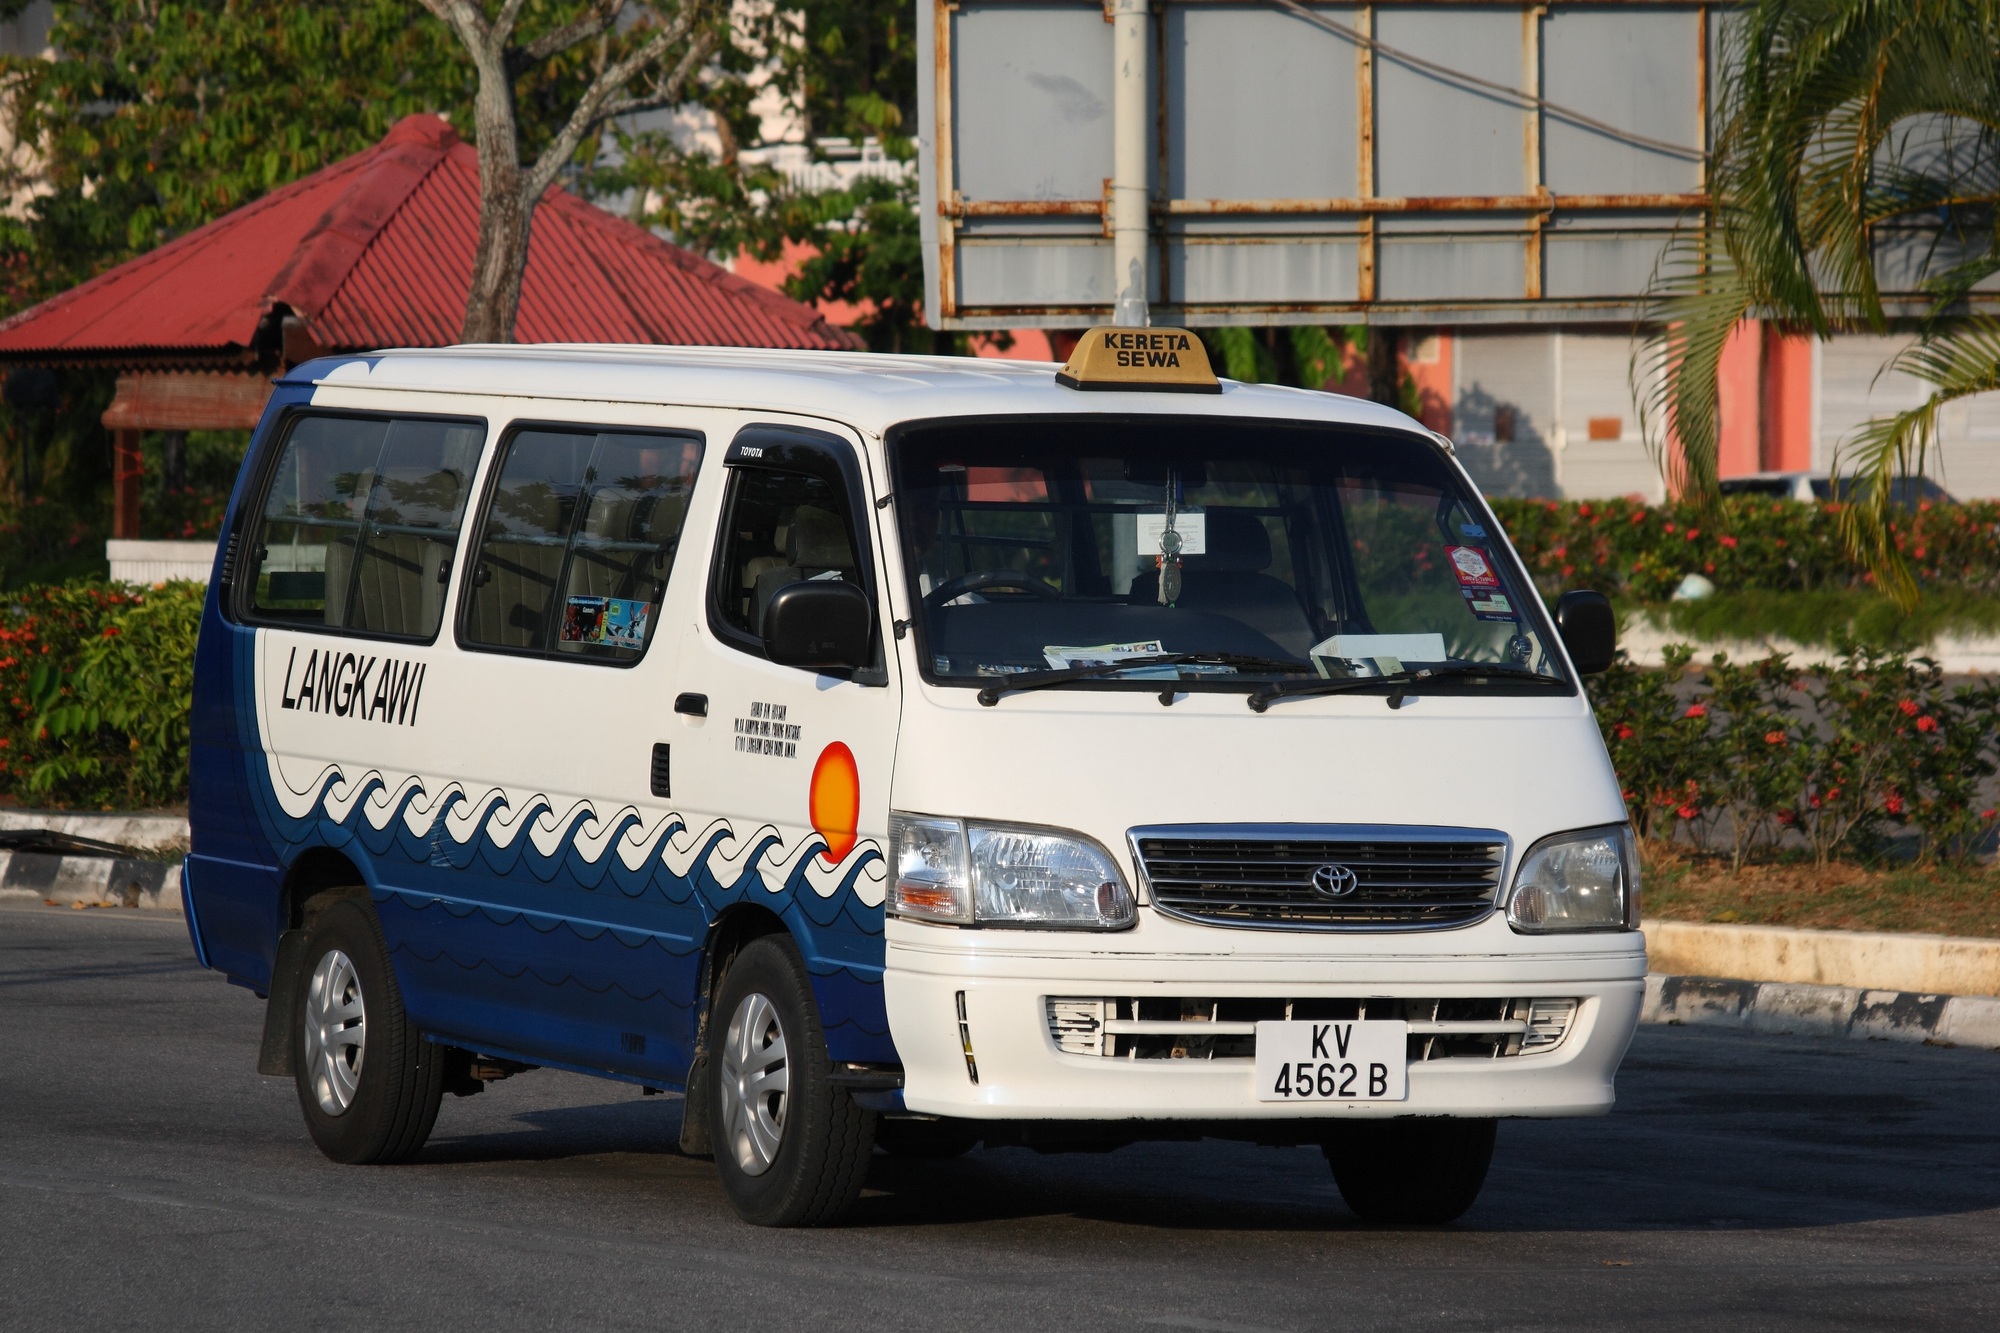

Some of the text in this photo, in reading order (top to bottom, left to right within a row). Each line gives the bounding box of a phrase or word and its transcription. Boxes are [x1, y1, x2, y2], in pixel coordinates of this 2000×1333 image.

[1104, 333, 1191, 350] KERETA
[1117, 350, 1180, 367] SEWA
[740, 446, 763, 458] TOYOTA
[281, 646, 427, 727] LANGKAWI
[1312, 1024, 1352, 1058] KV
[1274, 1063, 1388, 1097] 4562 B
